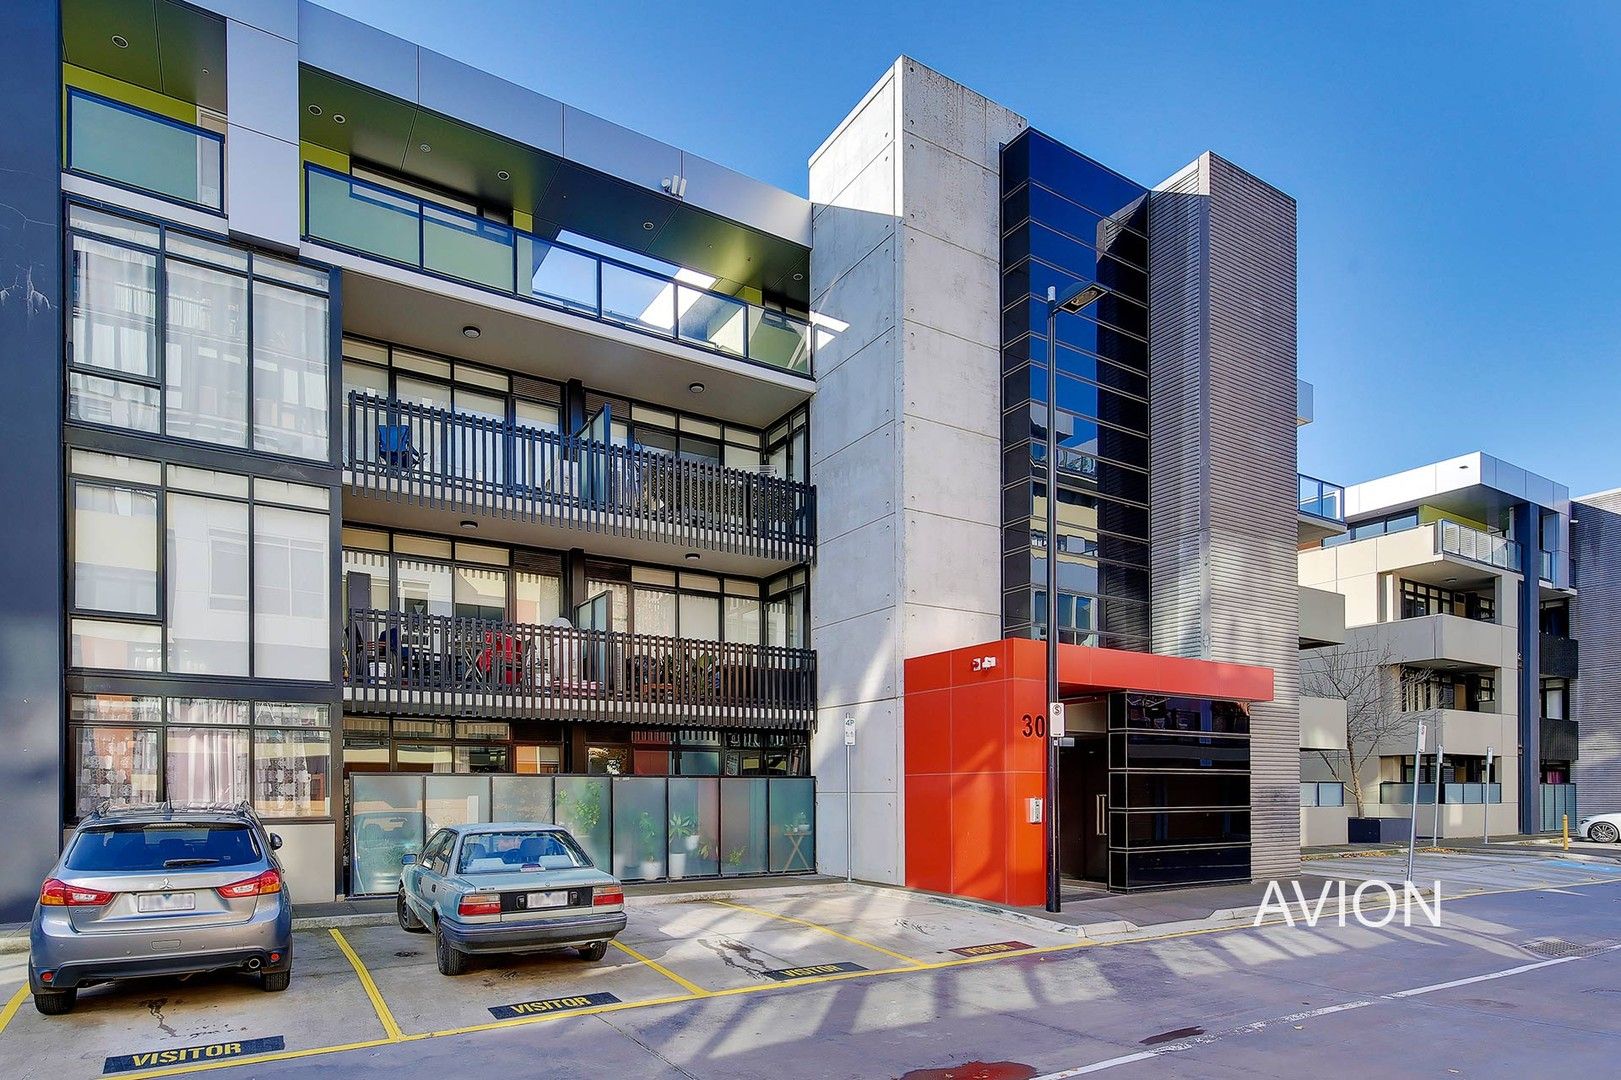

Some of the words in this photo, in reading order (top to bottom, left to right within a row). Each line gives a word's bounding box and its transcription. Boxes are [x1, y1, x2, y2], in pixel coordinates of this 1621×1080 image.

[1021, 714, 1045, 738] 30
[960, 944, 1015, 955] VISITOR
[780, 964, 844, 977] VISITOR
[510, 996, 592, 1014] VISITOR
[132, 1042, 242, 1067] VISITOR
